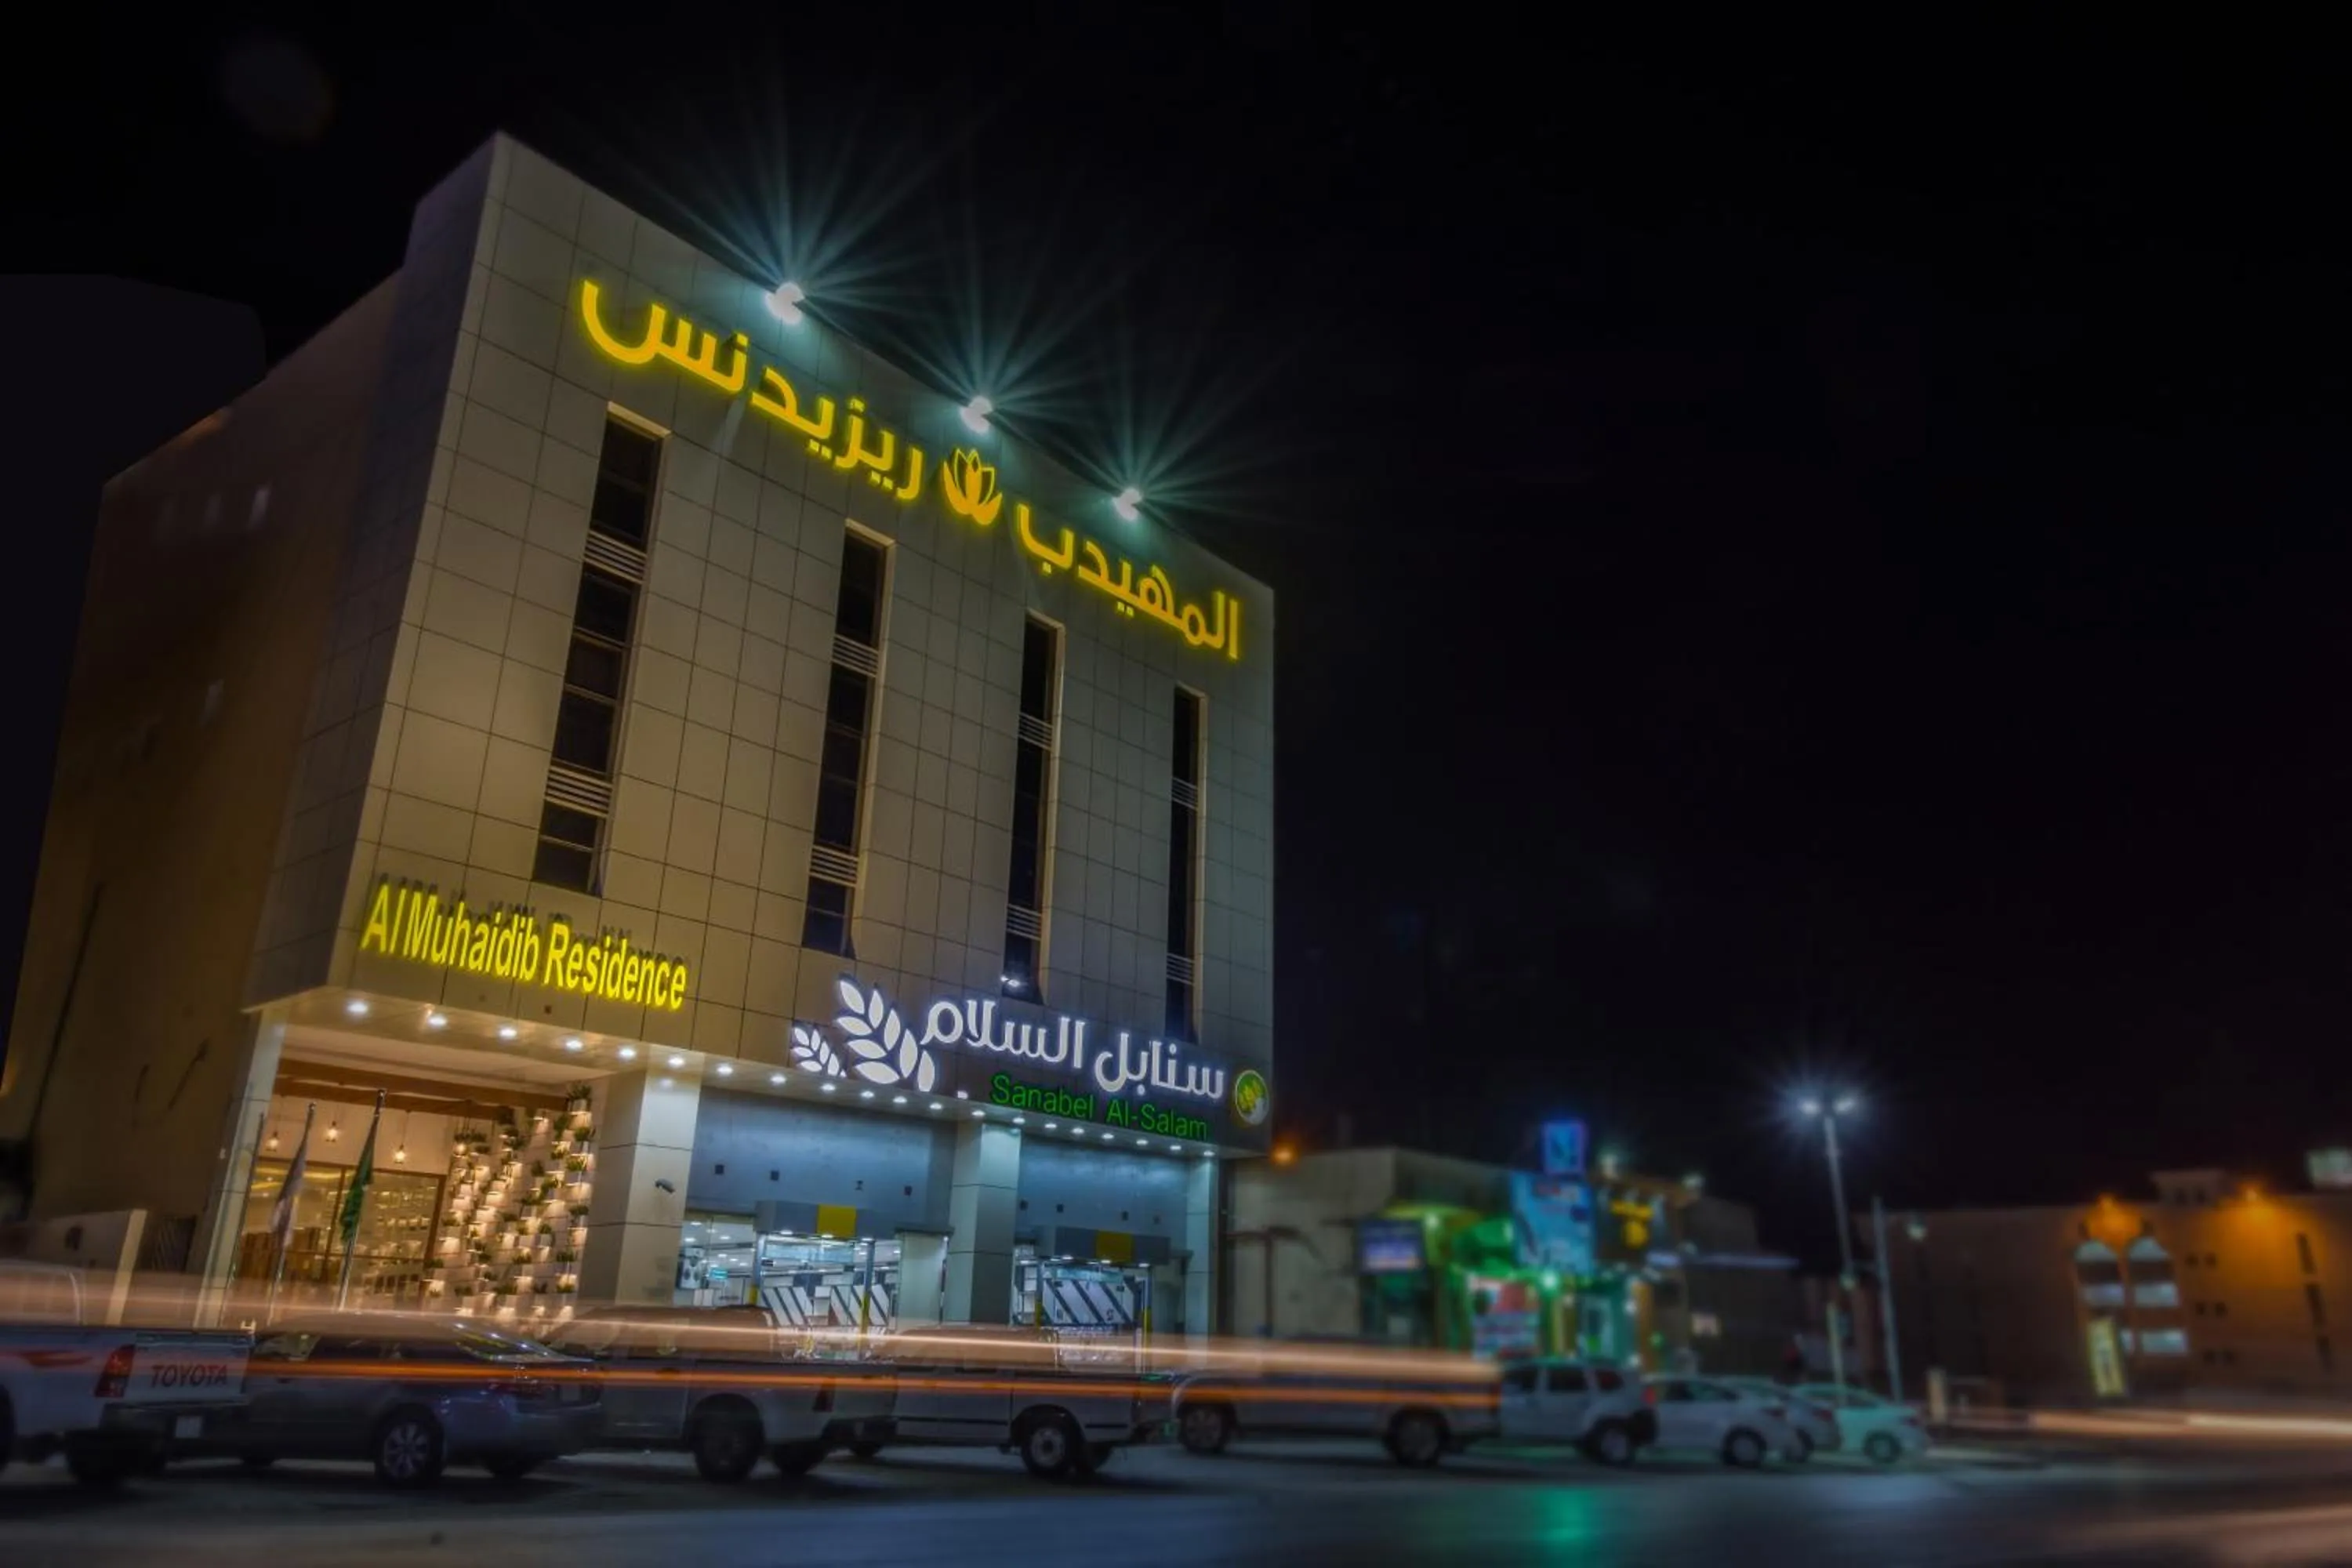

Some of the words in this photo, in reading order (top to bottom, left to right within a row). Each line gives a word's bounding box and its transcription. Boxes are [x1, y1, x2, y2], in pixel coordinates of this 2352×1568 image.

[581, 278, 924, 500] ريزيدنس
[1018, 504, 1240, 661] المهيدب
[361, 883, 405, 953] Al
[403, 891, 541, 981] Muhaidib
[543, 923, 688, 1010] Residence
[919, 999, 1087, 1069] السلام
[1094, 1030, 1226, 1101] سنابل
[990, 1074, 1094, 1120] Sanabel
[1105, 1099, 1208, 1142] Al-Salam
[151, 1364, 228, 1388] TOYOTA
